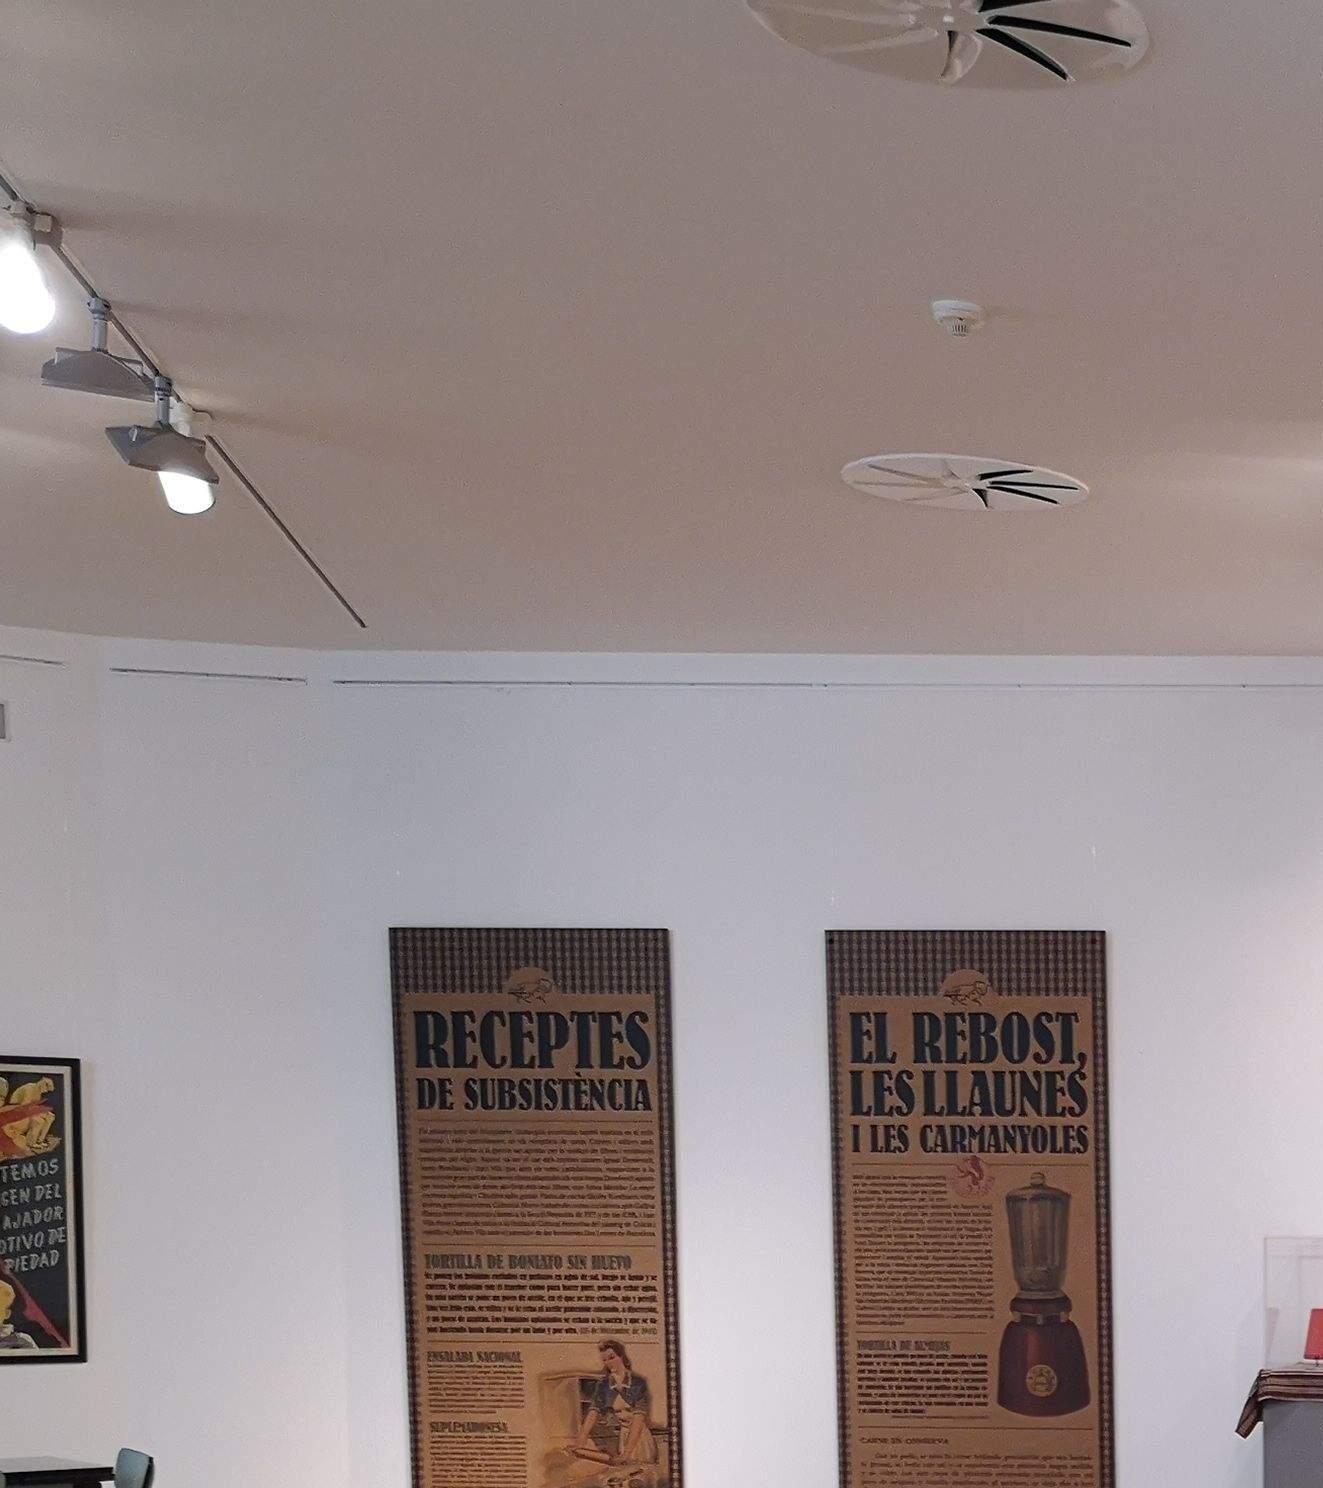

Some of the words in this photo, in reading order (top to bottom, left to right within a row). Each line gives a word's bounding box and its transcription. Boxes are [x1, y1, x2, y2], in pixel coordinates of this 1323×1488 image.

[413, 1010, 652, 1070] RECEPTES
[849, 1012, 897, 1064] EL
[912, 1011, 1088, 1072] REBOST,
[415, 1078, 455, 1110] DE
[464, 1071, 652, 1112] SUBSISTÈNCIA
[849, 1070, 915, 1117] LES
[922, 1070, 1088, 1118] LLAUNES
[851, 1124, 861, 1153] I
[870, 1124, 910, 1153] LES
[920, 1124, 1089, 1154] CARMANYOLES
[35, 1183, 62, 1201] DEL
[48, 1226, 67, 1244] DE
